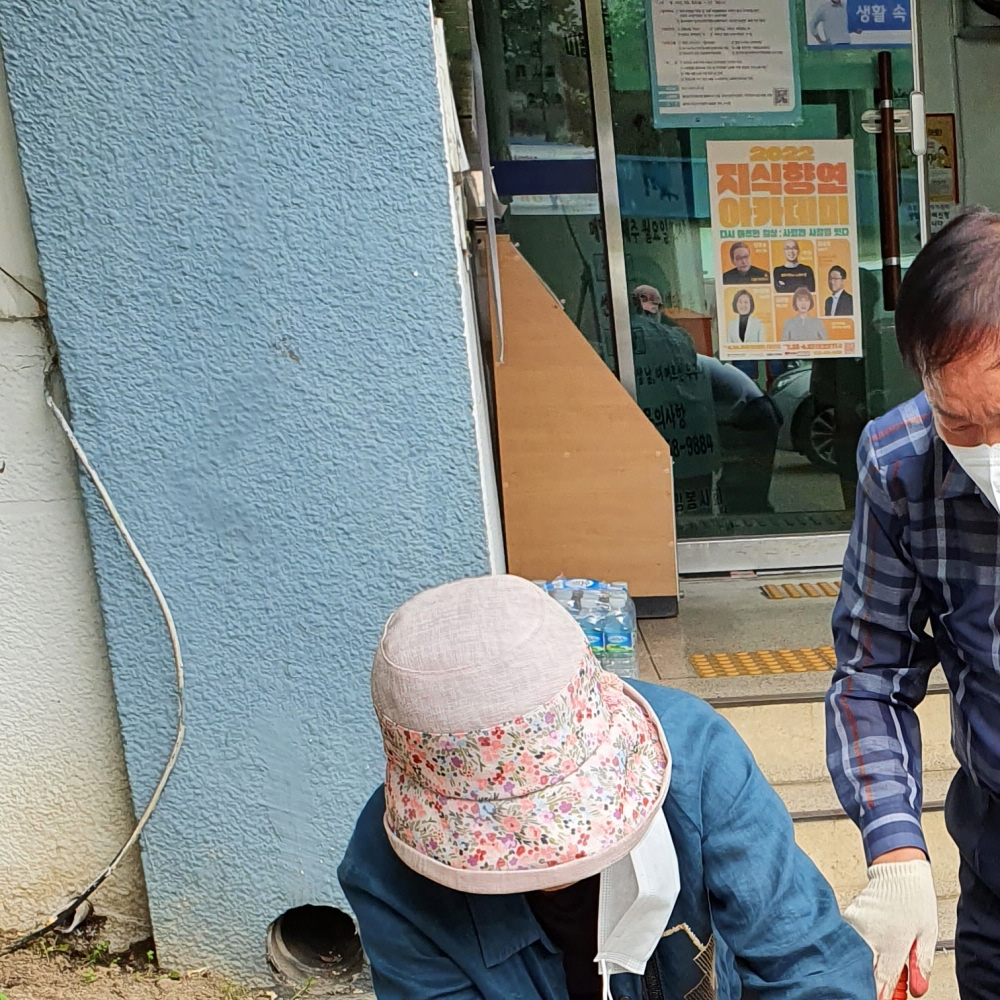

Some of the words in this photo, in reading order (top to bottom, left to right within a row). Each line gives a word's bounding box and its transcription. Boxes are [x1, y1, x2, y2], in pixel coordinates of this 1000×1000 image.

[856, 5, 887, 23] 생활
[892, 4, 907, 22] 속
[750, 145, 815, 161] 2022
[715, 162, 848, 195] 지식향연
[717, 195, 849, 228] 아카데미
